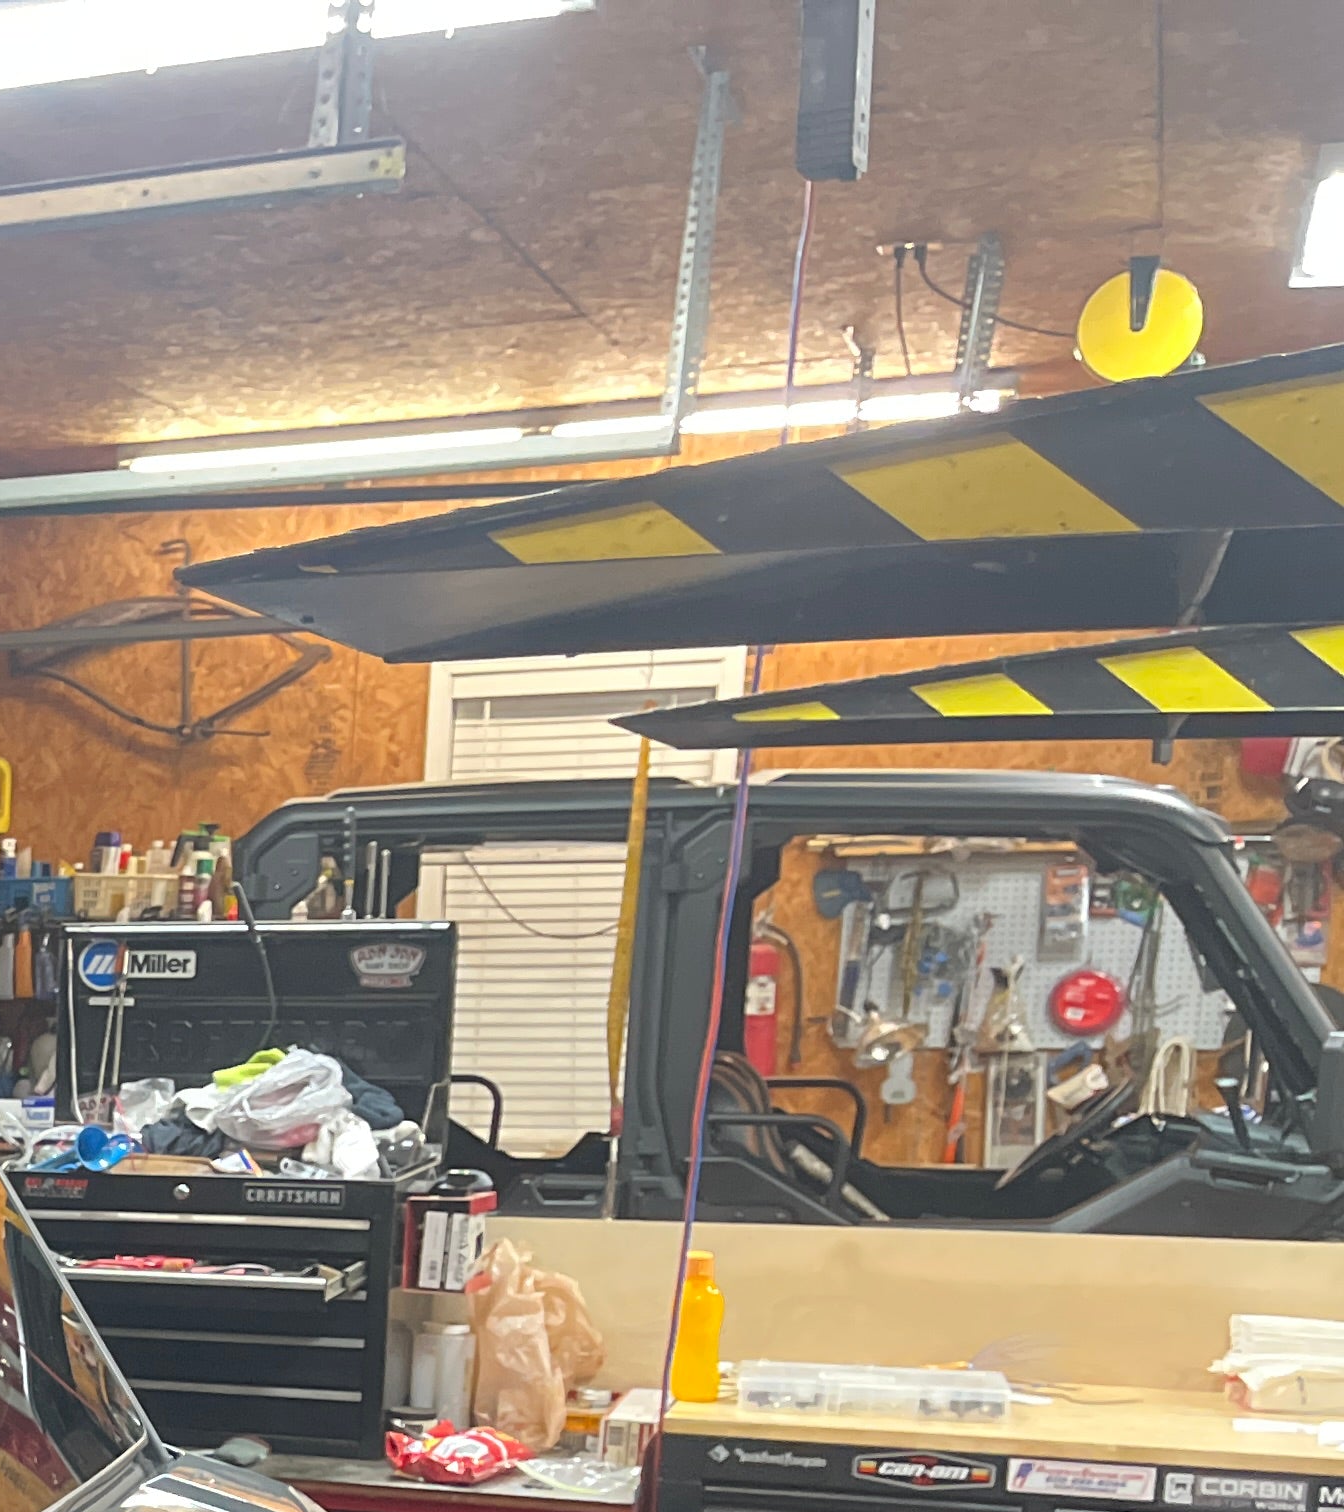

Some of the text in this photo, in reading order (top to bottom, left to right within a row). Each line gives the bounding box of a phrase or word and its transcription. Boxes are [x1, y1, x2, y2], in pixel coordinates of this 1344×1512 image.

[130, 954, 191, 973] Miller
[246, 1188, 341, 1205] CRAFTSMAN
[1200, 1477, 1304, 1500] CORBIN
